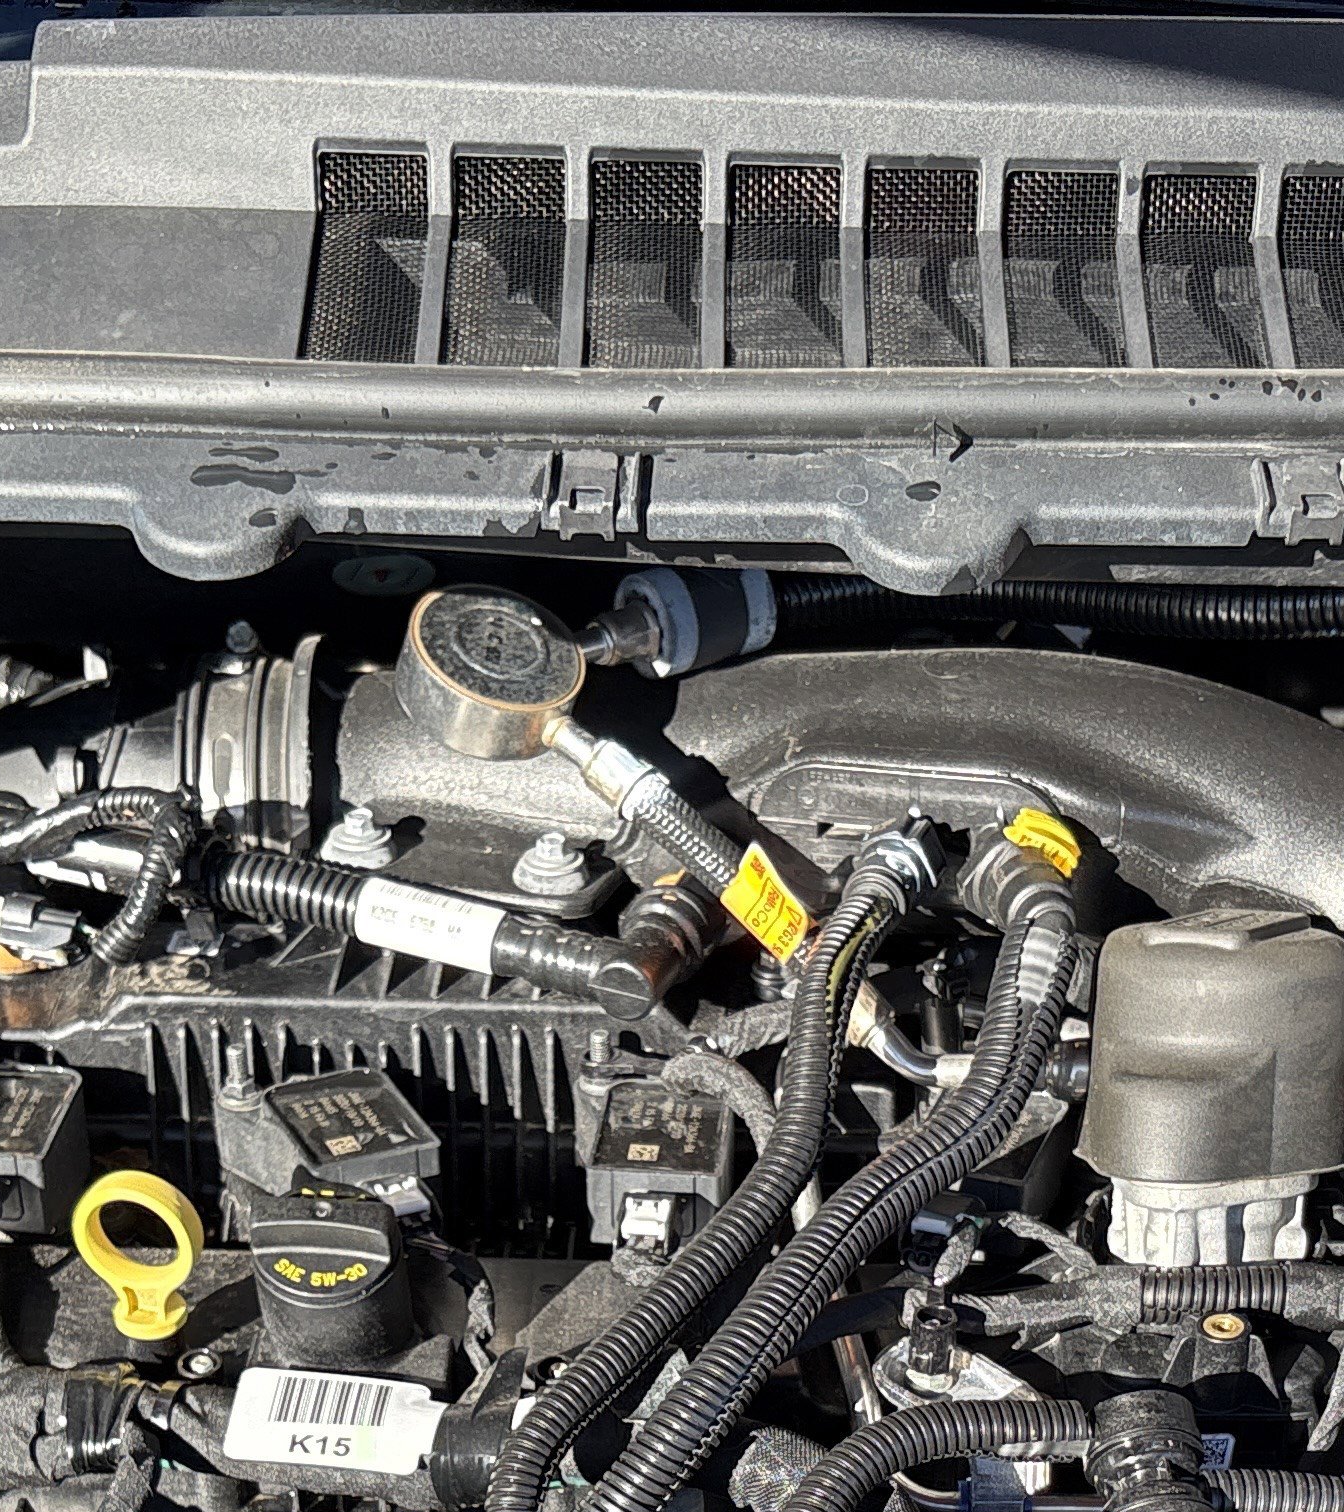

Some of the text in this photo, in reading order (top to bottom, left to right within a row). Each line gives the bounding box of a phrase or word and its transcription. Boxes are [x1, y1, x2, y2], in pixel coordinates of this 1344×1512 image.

[273, 1257, 369, 1288] SAE 5W-30
[288, 1433, 352, 1457] K15
